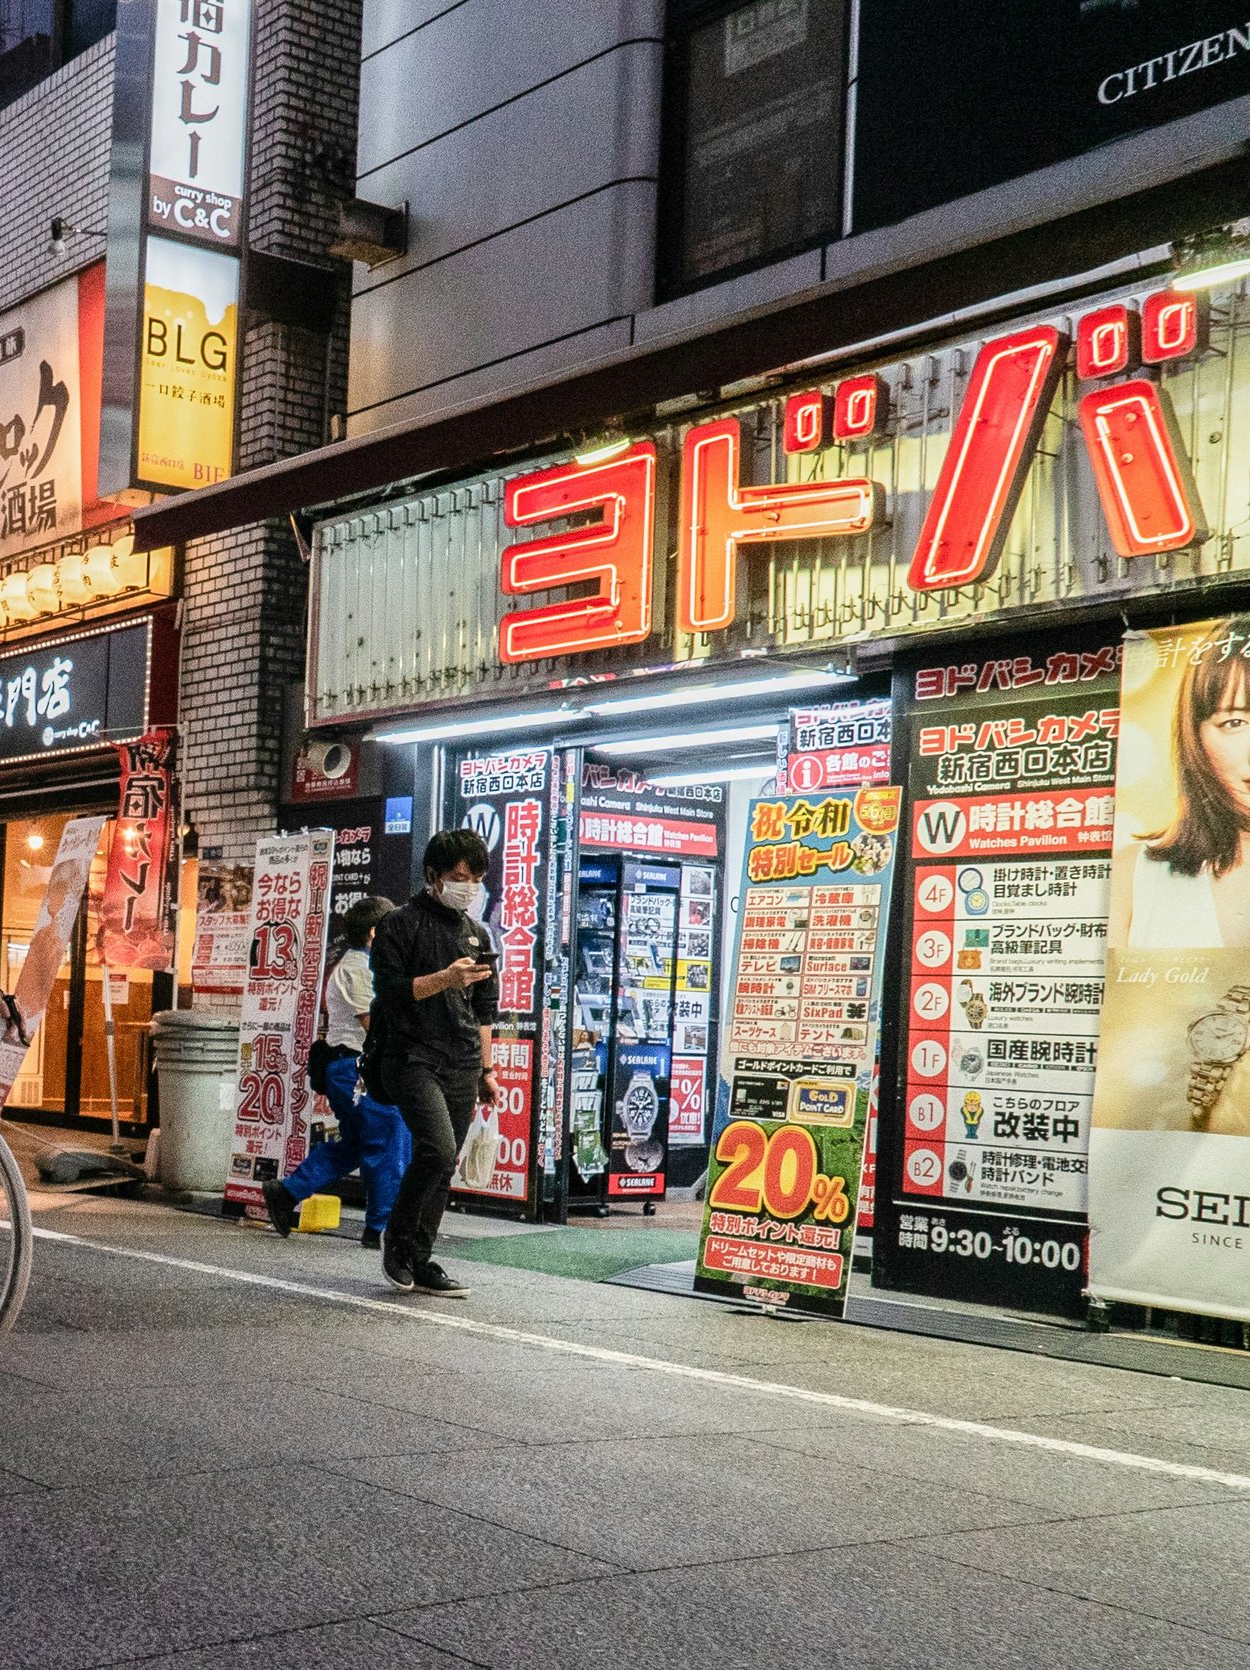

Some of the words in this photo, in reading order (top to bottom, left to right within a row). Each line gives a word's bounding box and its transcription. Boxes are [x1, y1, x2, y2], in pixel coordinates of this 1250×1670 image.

[1097, 22, 1250, 105] CITIZEN
[174, 183, 205, 202] curry
[205, 190, 233, 212] shop
[152, 195, 170, 220] by
[173, 199, 232, 239] C&C
[147, 316, 228, 373] BLG
[145, 383, 225, 409] 一口餃子酒場
[499, 288, 1198, 664] ヨドバ
[0, 478, 57, 540] 酒場
[915, 646, 1124, 700] ヨドバシカメ
[461, 753, 548, 778] ヨドバシカメラ
[937, 741, 1113, 784] 新宿西口本店
[462, 772, 546, 797] 新宿西口本店
[927, 782, 974, 795] Yodobashi
[975, 781, 1011, 792] Camera
[1016, 778, 1051, 789] Shinjuku
[1051, 777, 1072, 785] West
[1072, 775, 1092, 784] Main
[1092, 773, 1115, 782] Store
[598, 797, 632, 812] Camera
[968, 794, 1116, 834] 時計総合館
[751, 797, 853, 843] 祝令和
[923, 810, 963, 845] W
[584, 815, 664, 848] 時計総合館
[969, 836, 1018, 849] Watches
[1019, 834, 1067, 847] Pavilion
[747, 841, 853, 884] 特別セール
[993, 862, 1113, 882] 掛け時計・置き時計
[257, 871, 302, 897] 今なら
[925, 883, 947, 903] 4F
[993, 881, 1078, 899] 目覚まし時計
[497, 798, 542, 1015] 時計総合館
[747, 895, 784, 906] エアコン
[814, 891, 855, 904] 冷蔵庫
[256, 897, 302, 921] お得な
[744, 916, 787, 928] 調理家電
[812, 914, 853, 927] 洗濯機
[992, 921, 1108, 939] ブランドバッグ・財布
[250, 923, 299, 981] 13%
[742, 938, 780, 950] 掃除機
[923, 937, 945, 959] 3F
[990, 939, 1063, 955] 高級筆記具
[741, 961, 778, 972] テレビ
[806, 961, 848, 973] Surface
[1116, 966, 1158, 988] Lady
[1164, 966, 1210, 985] Gold
[247, 981, 299, 997] 特別ポイント
[737, 982, 776, 995] 腕時計
[817, 984, 853, 996] フリースマホ
[988, 981, 1106, 1004] 海外ブランド腕時計
[921, 990, 943, 1012] 2F
[803, 1006, 844, 1019] SixPad
[734, 1025, 777, 1038] スーツケース
[799, 1029, 836, 1042] テント
[627, 1054, 658, 1066] SEALANE
[920, 1047, 940, 1068] 1F
[986, 1038, 1098, 1064] 国産腕時計
[737, 1059, 853, 1076] ゴールドポイントカードご利用で
[237, 1072, 285, 1125] 20%
[808, 1090, 839, 1103] GOLD
[993, 1096, 1081, 1112] こちらのフロア
[917, 1102, 935, 1122] B1
[235, 1122, 283, 1141] 特別ポイント
[993, 1111, 1080, 1144] 改装中
[708, 1120, 850, 1224] 20%
[914, 1157, 935, 1178] B2
[980, 1166, 1055, 1188] 時計バンド
[626, 1177, 656, 1189] SEALANE
[709, 1212, 841, 1250] 特別ポイント還元!
[899, 1214, 929, 1233] 営業
[898, 1231, 928, 1250] 時間
[1192, 1232, 1244, 1249] SINCE
[710, 1240, 837, 1271] ドリームセットや限定商材も
